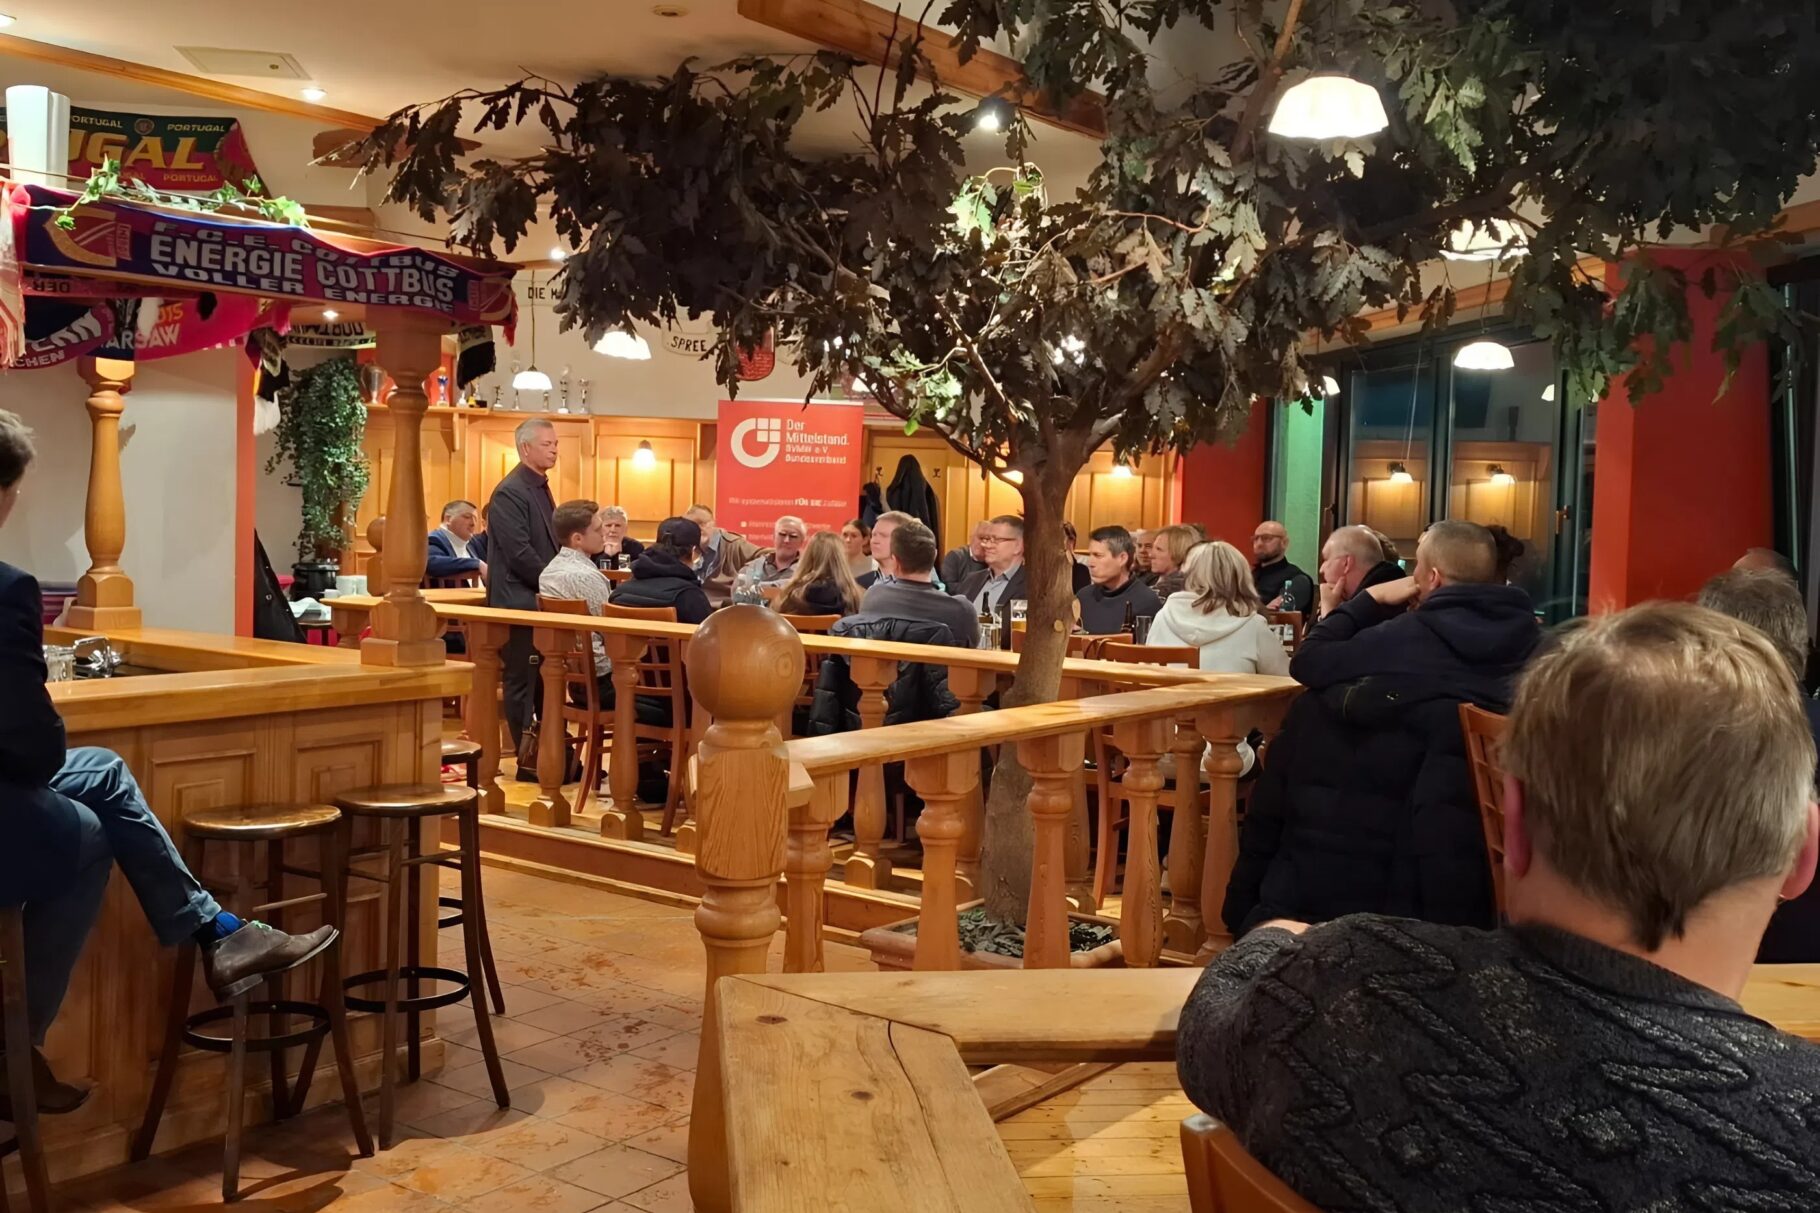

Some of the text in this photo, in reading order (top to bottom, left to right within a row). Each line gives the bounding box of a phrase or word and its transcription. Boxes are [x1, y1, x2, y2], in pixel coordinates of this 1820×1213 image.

[71, 115, 123, 129] ORTUGAL
[167, 124, 225, 132] PORTUGAL
[151, 234, 303, 280] ENERGIE
[317, 260, 454, 302] COTTBUS
[152, 262, 304, 294] VOLLER
[325, 287, 454, 312] ENERGIE
[101, 322, 180, 350] ARSAW
[670, 335, 707, 353] SPREE
[15, 349, 65, 367] CHEN
[786, 419, 805, 431] Der
